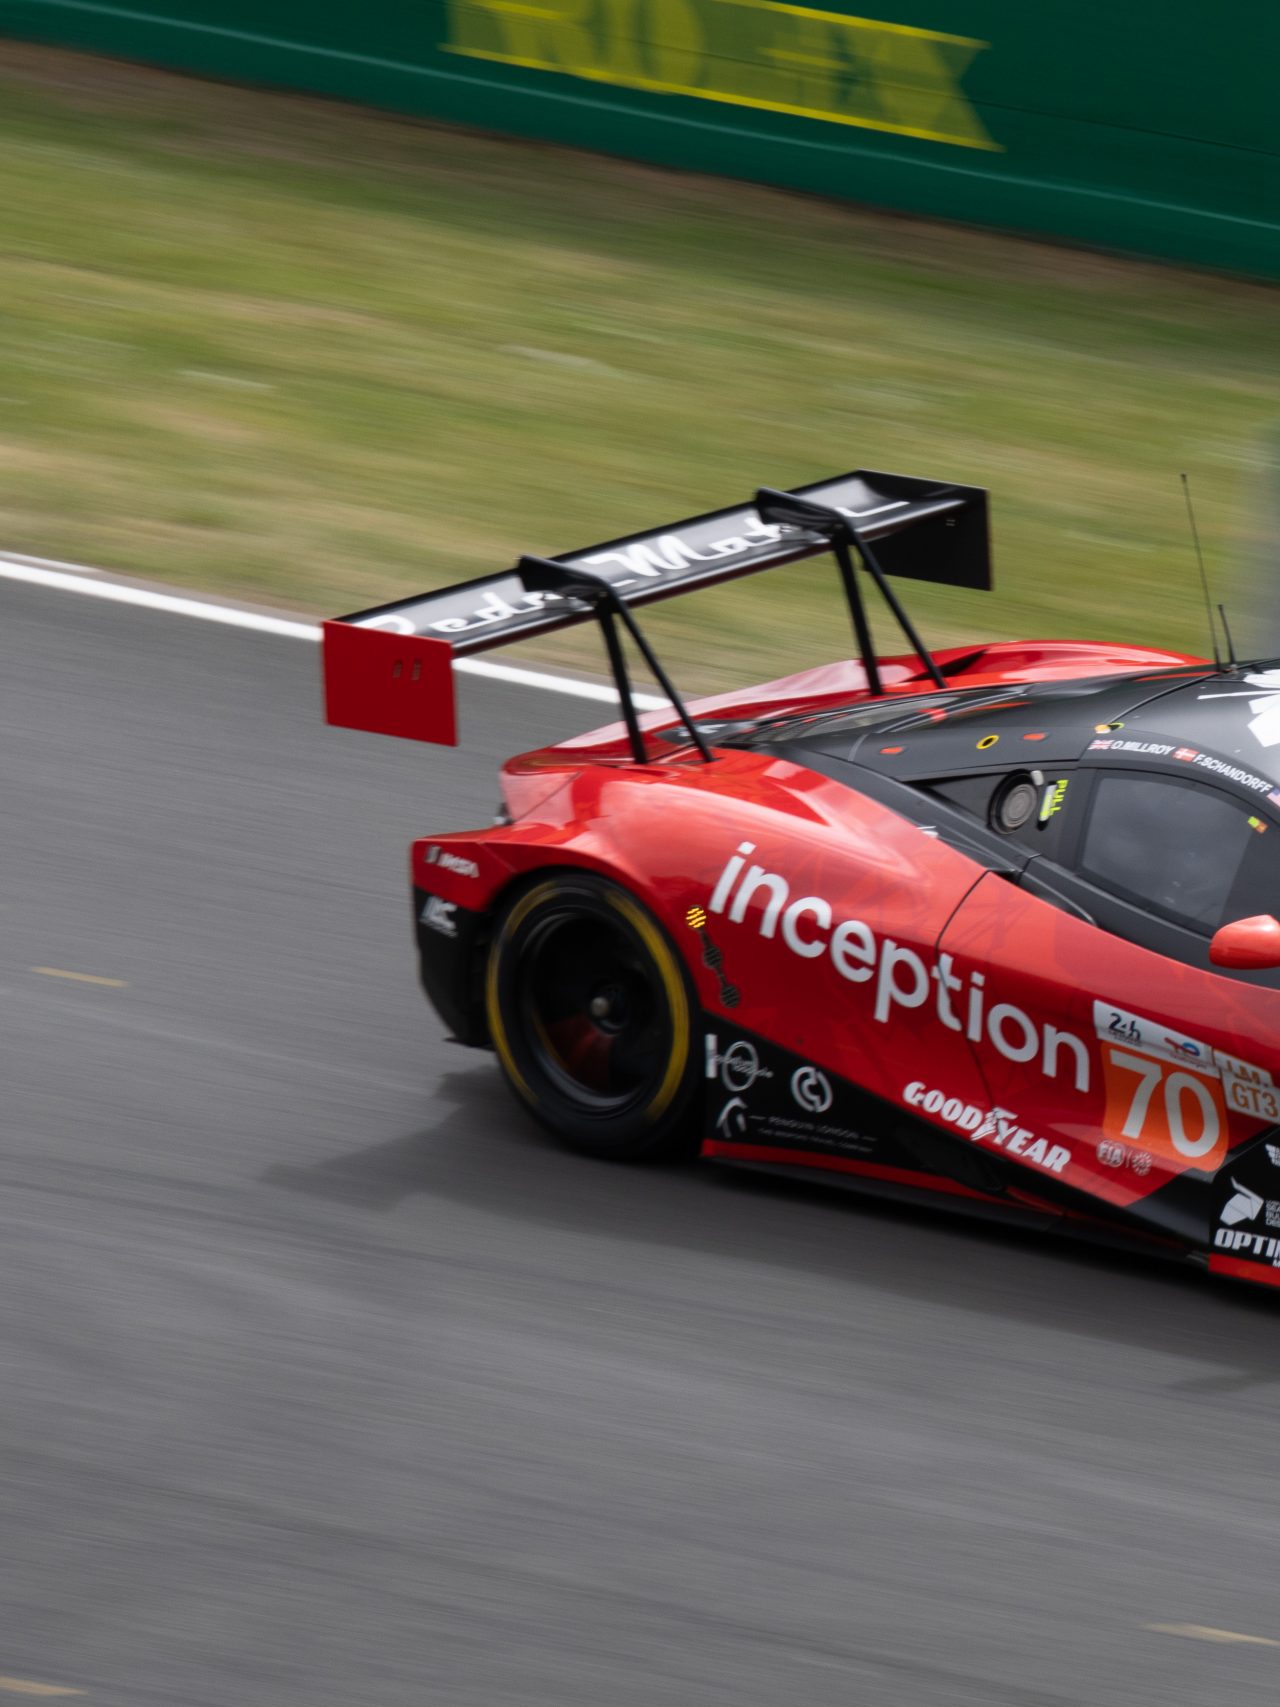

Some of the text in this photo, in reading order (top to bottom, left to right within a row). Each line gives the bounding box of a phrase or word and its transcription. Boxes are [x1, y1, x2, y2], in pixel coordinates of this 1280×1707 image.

[438, 0, 1007, 153] ROEX
[1048, 779, 1069, 817] PULL
[1193, 754, 1273, 794] F.SCHANDORFF
[708, 841, 1090, 1093] inception
[1108, 1012, 1142, 1041] 24h
[903, 1081, 1071, 1173] GOODYEAR
[1109, 1048, 1220, 1158] 70
[1231, 1081, 1279, 1118] GT3
